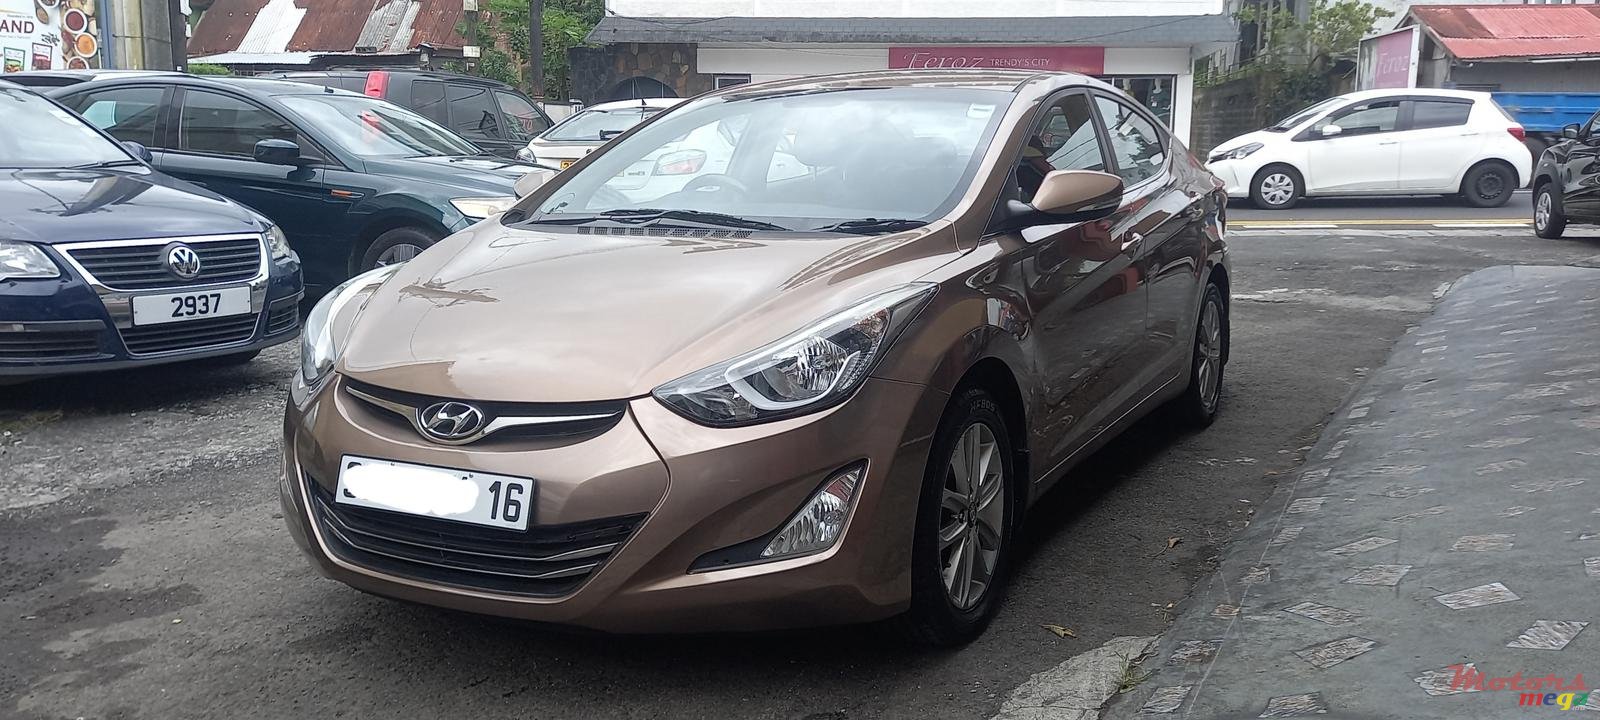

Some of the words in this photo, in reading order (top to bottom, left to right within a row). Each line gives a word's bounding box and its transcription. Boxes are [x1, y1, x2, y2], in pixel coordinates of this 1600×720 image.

[0, 20, 35, 34] AND
[903, 52, 985, 69] Feroz
[990, 58, 1030, 67] TRENDY'S
[1031, 58, 1050, 67] CITY
[171, 293, 221, 318] 2937
[488, 480, 524, 523] 16
